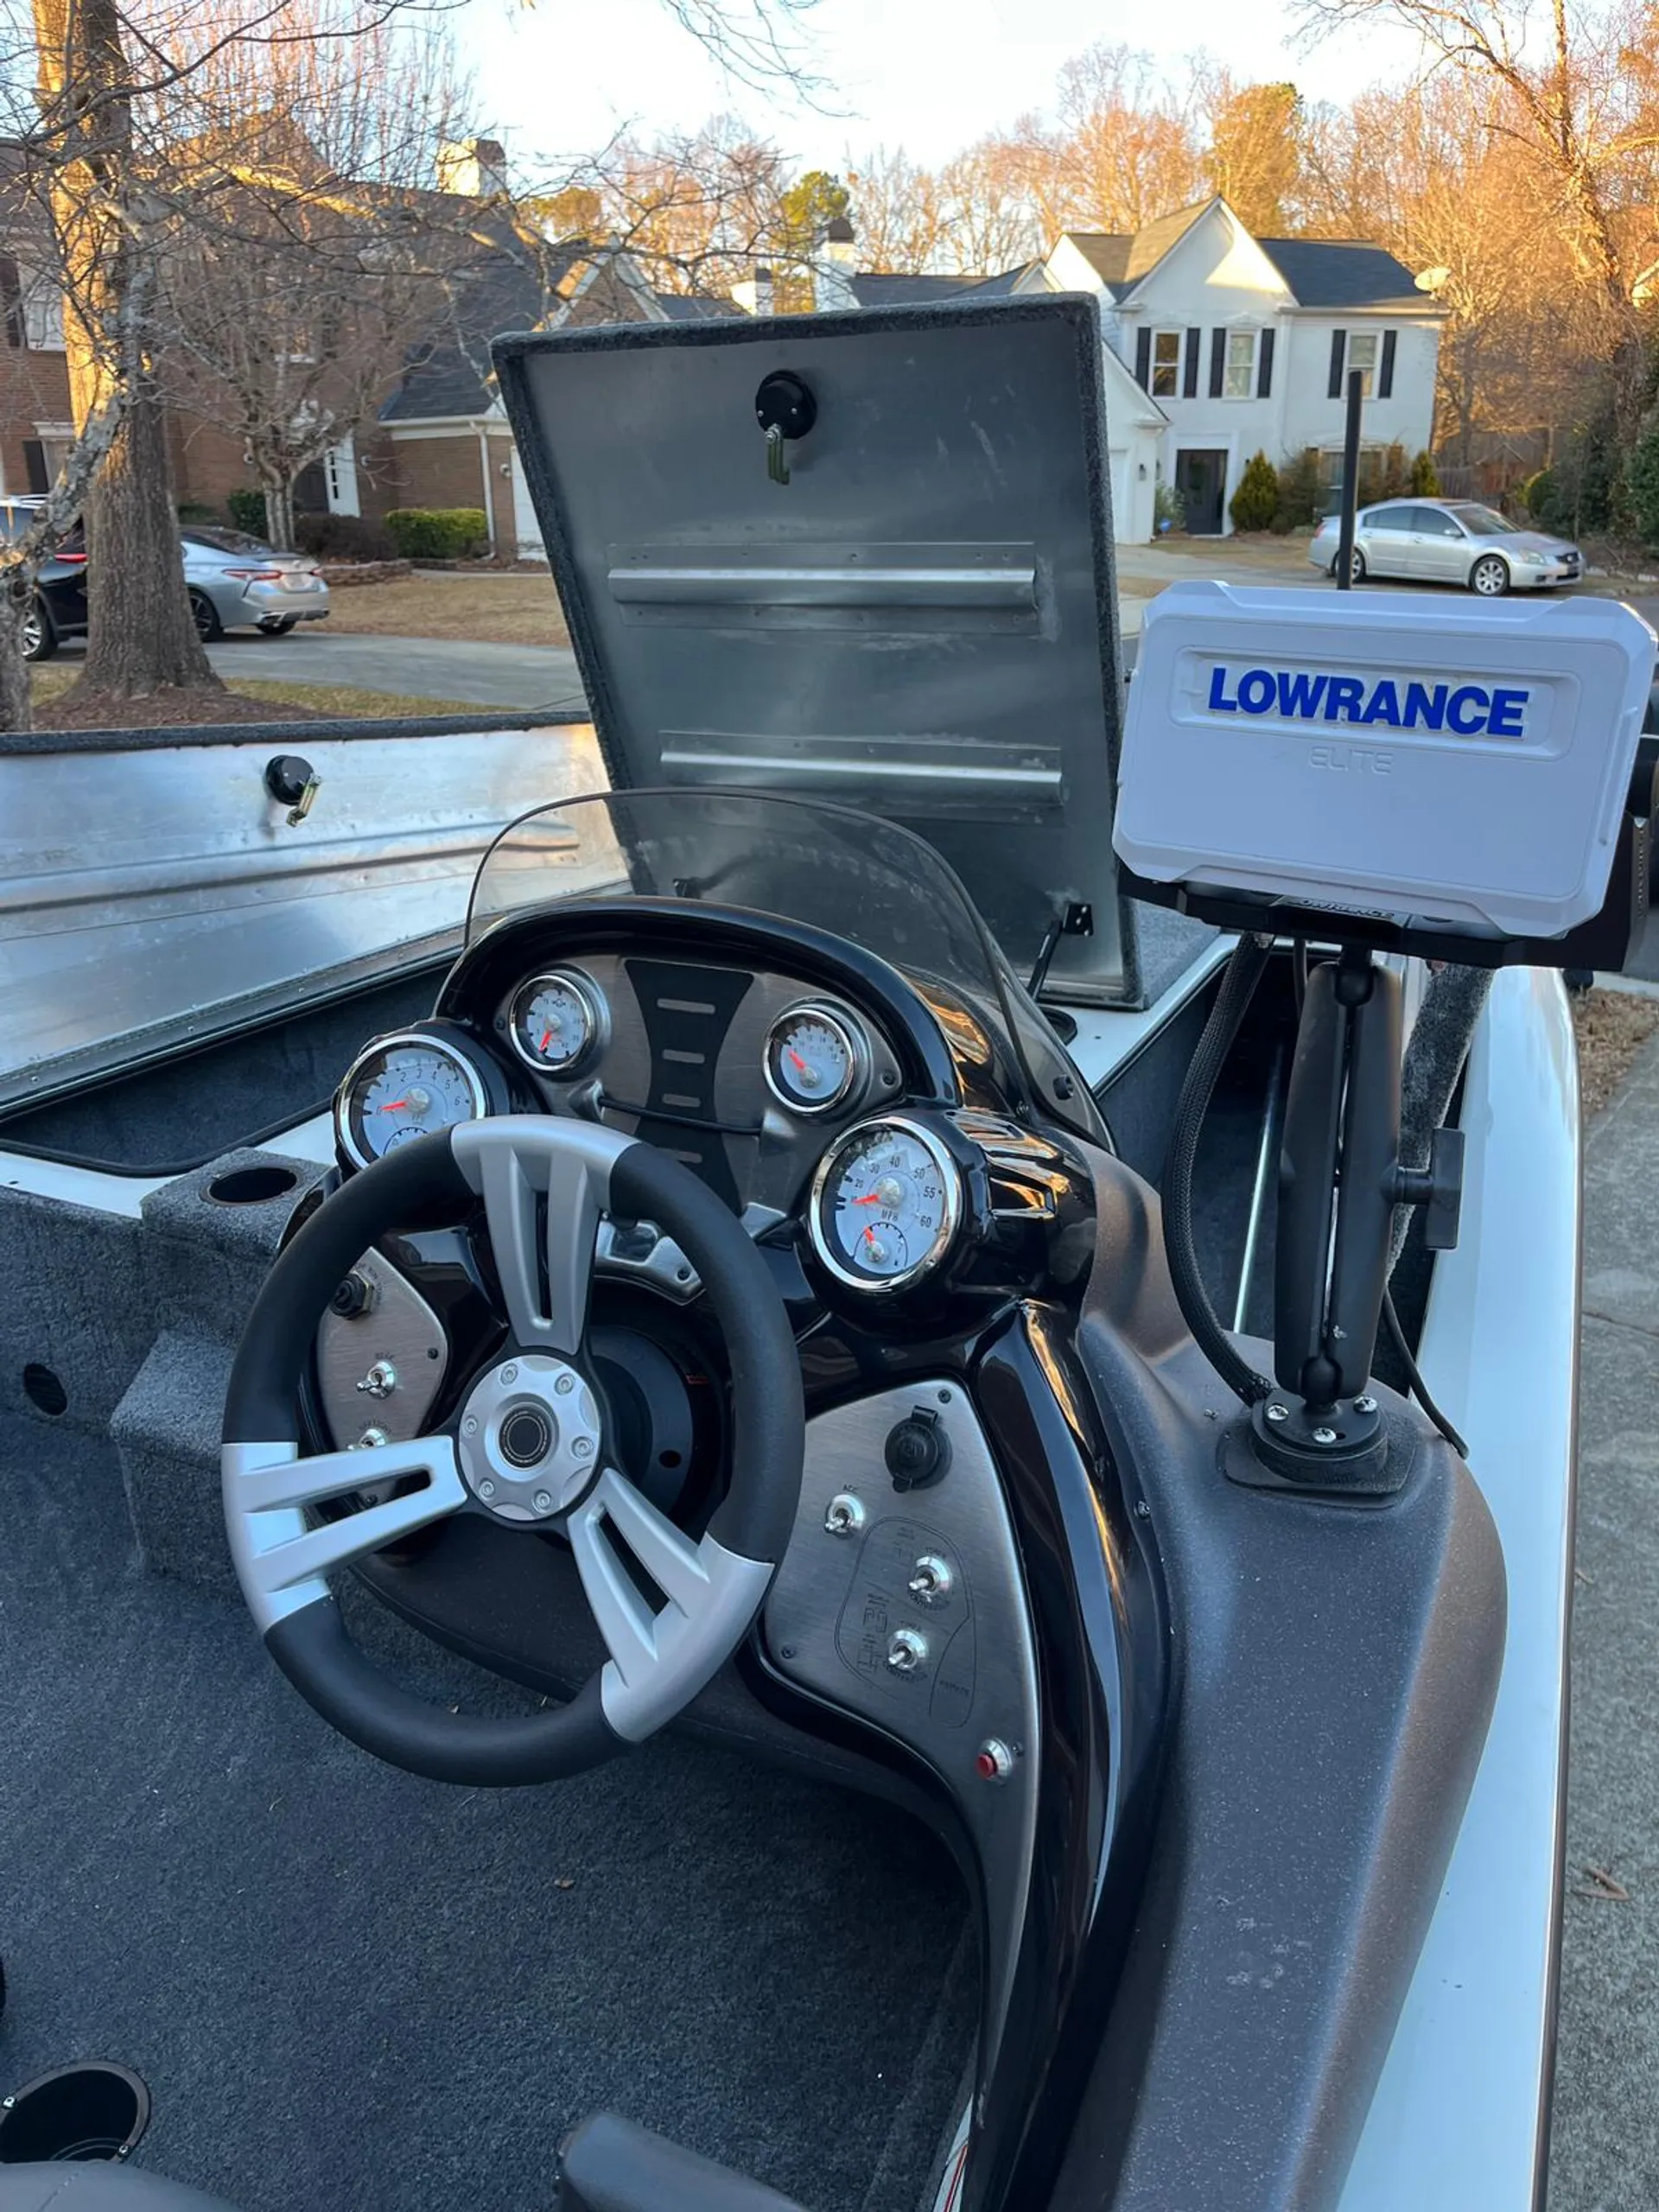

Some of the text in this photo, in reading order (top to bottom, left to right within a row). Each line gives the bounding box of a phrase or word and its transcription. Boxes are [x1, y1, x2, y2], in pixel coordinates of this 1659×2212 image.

[1209, 667, 1529, 738] LOWRANCE
[1307, 746, 1393, 775] ELITE
[400, 1072, 407, 1083] 2
[431, 1071, 438, 1081] 4
[444, 1079, 452, 1090] 5
[454, 1096, 461, 1106] 6
[889, 1155, 901, 1168] 40
[913, 1167, 925, 1179] 50
[923, 1185, 937, 1198] 55
[919, 1215, 932, 1229] 60
